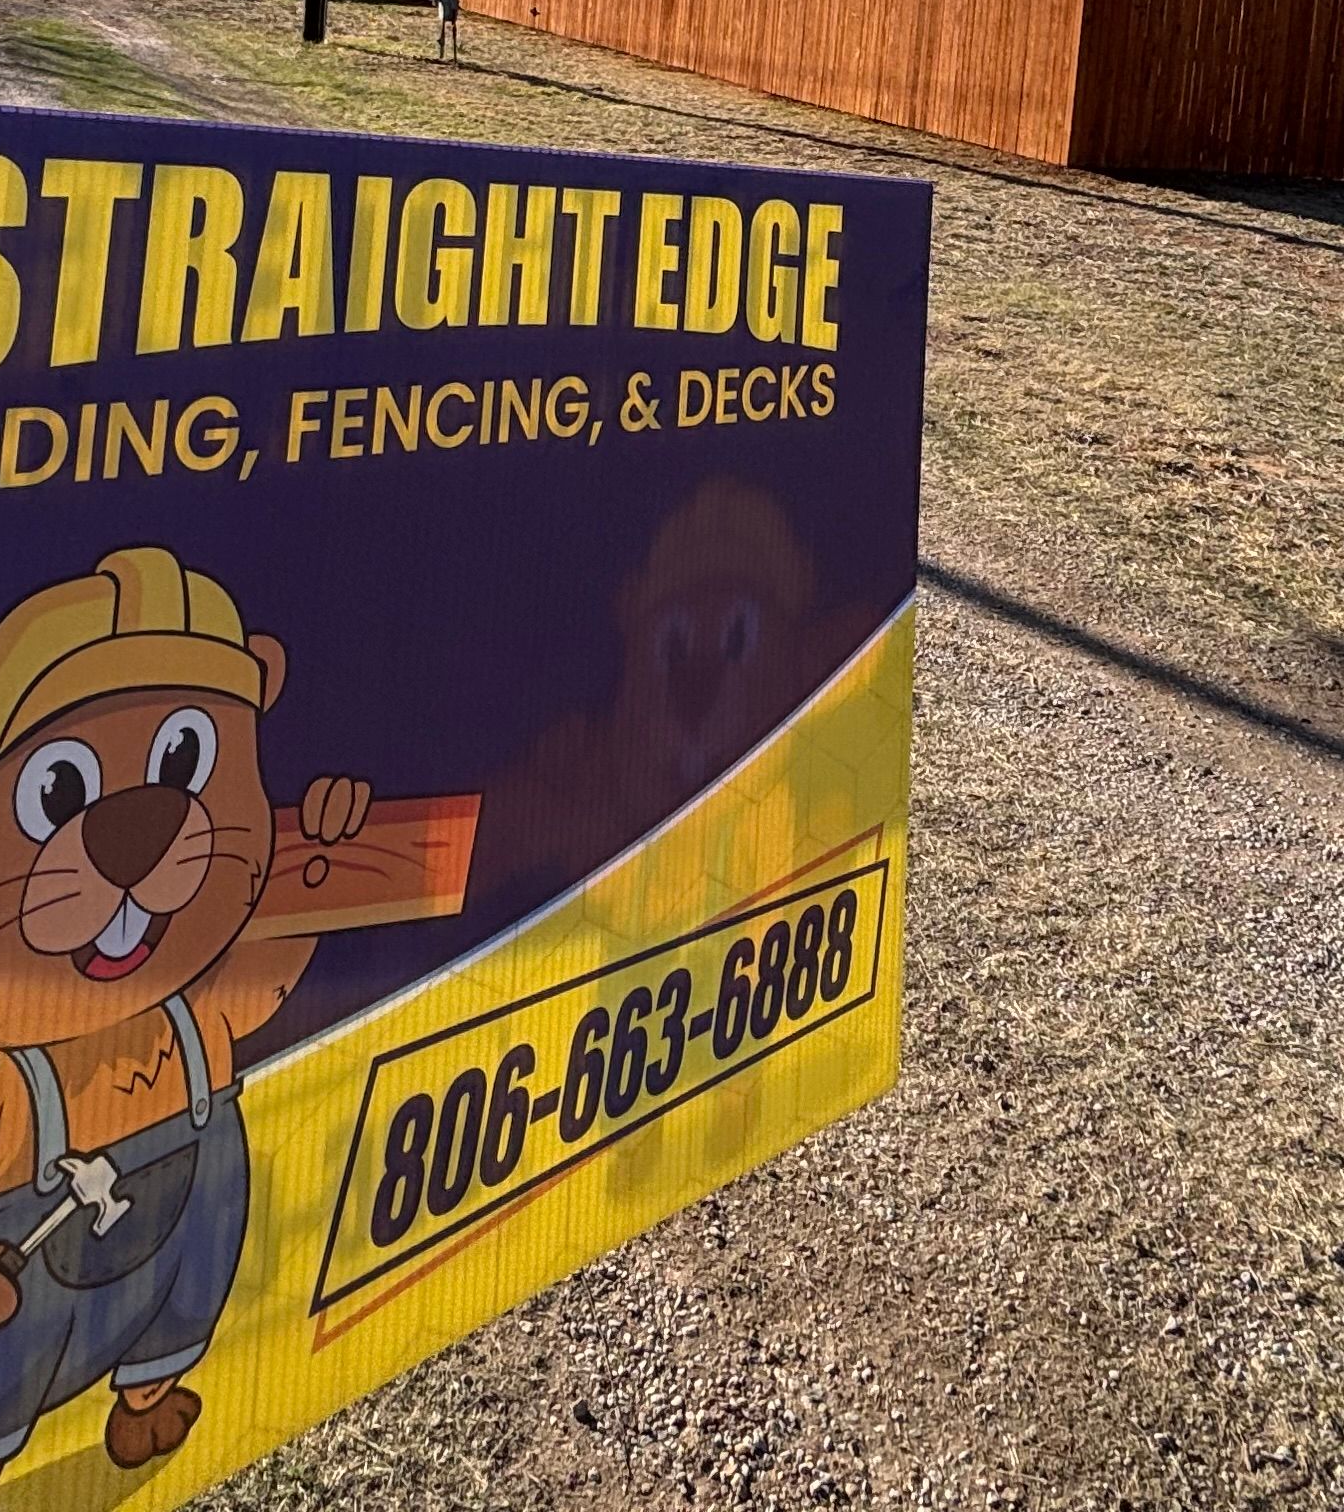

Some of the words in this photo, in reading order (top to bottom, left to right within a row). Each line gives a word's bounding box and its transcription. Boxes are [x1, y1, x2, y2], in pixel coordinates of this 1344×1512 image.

[286, 375, 603, 464] FENCING,
[619, 384, 662, 433] &
[677, 363, 837, 429] DECKS
[370, 889, 858, 1248] 806-663-6888
